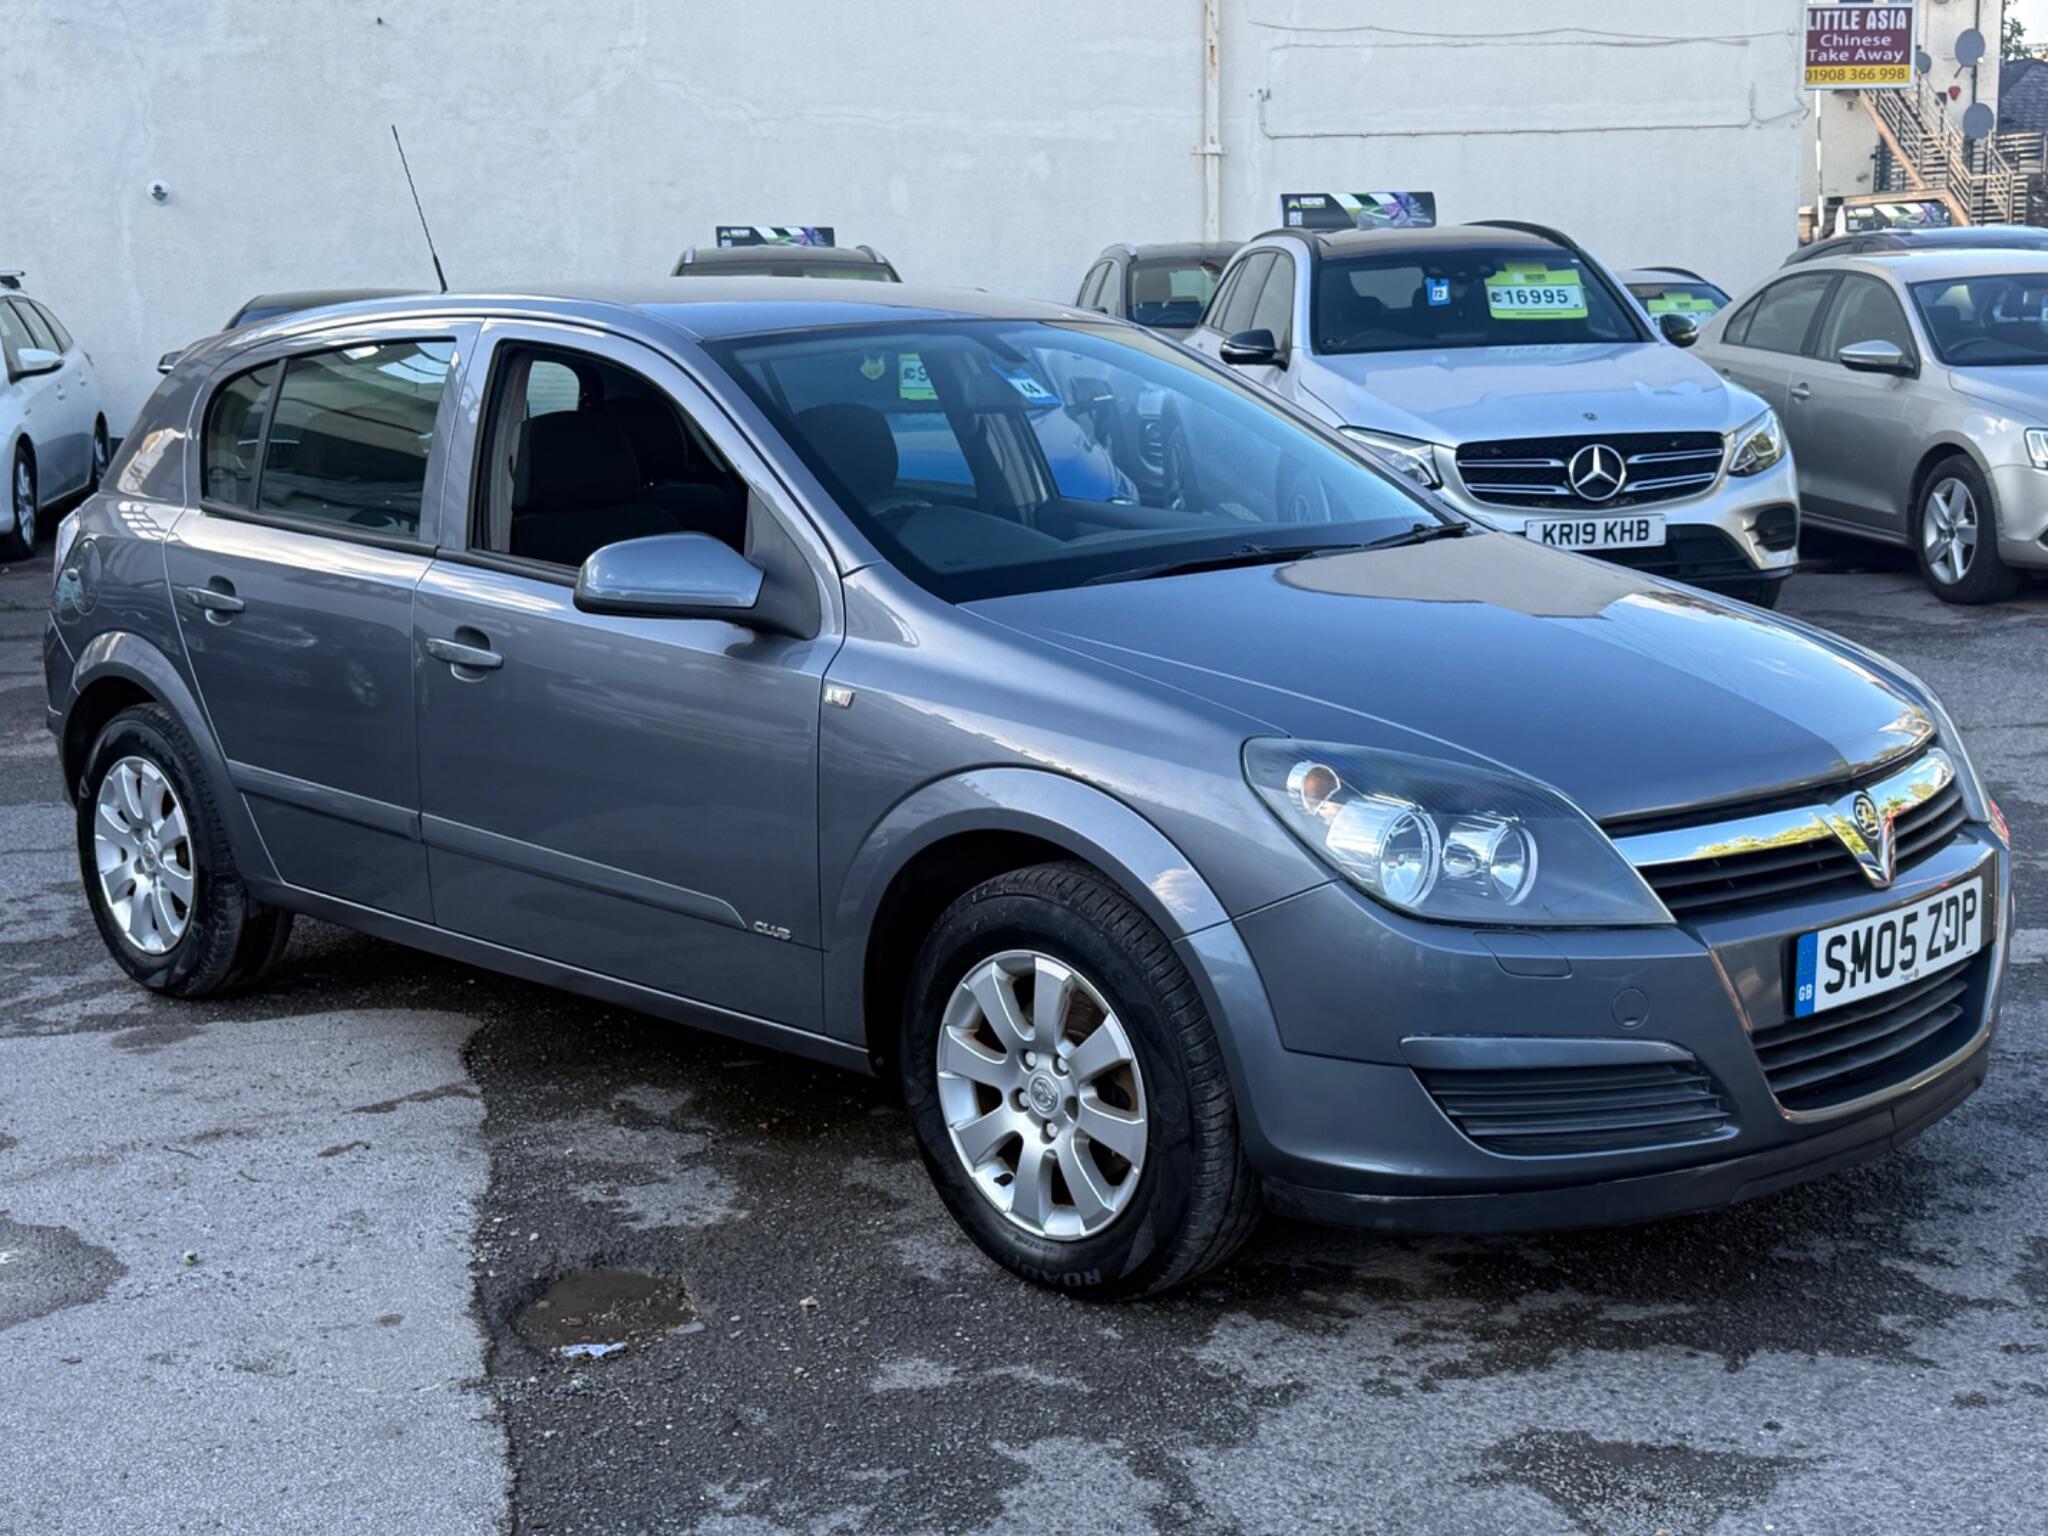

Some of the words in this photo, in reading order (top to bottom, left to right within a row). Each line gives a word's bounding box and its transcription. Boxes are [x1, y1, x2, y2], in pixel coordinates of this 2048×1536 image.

[1807, 10, 1860, 30] LITTLE
[1866, 9, 1907, 30] ASIA
[1820, 34, 1892, 47] Chinese
[1808, 49, 1849, 62] Take
[1854, 49, 1904, 63] Away
[1805, 69, 1845, 81] 01908
[1850, 68, 1876, 80] 366
[1880, 67, 1905, 79] 998
[1491, 289, 1568, 305] £16995
[1542, 522, 1596, 545] KR19
[1604, 519, 1650, 543] KHB
[1824, 911, 1918, 994] SM05
[1926, 888, 1976, 962] ZDP
[1799, 984, 1813, 1001] GB
